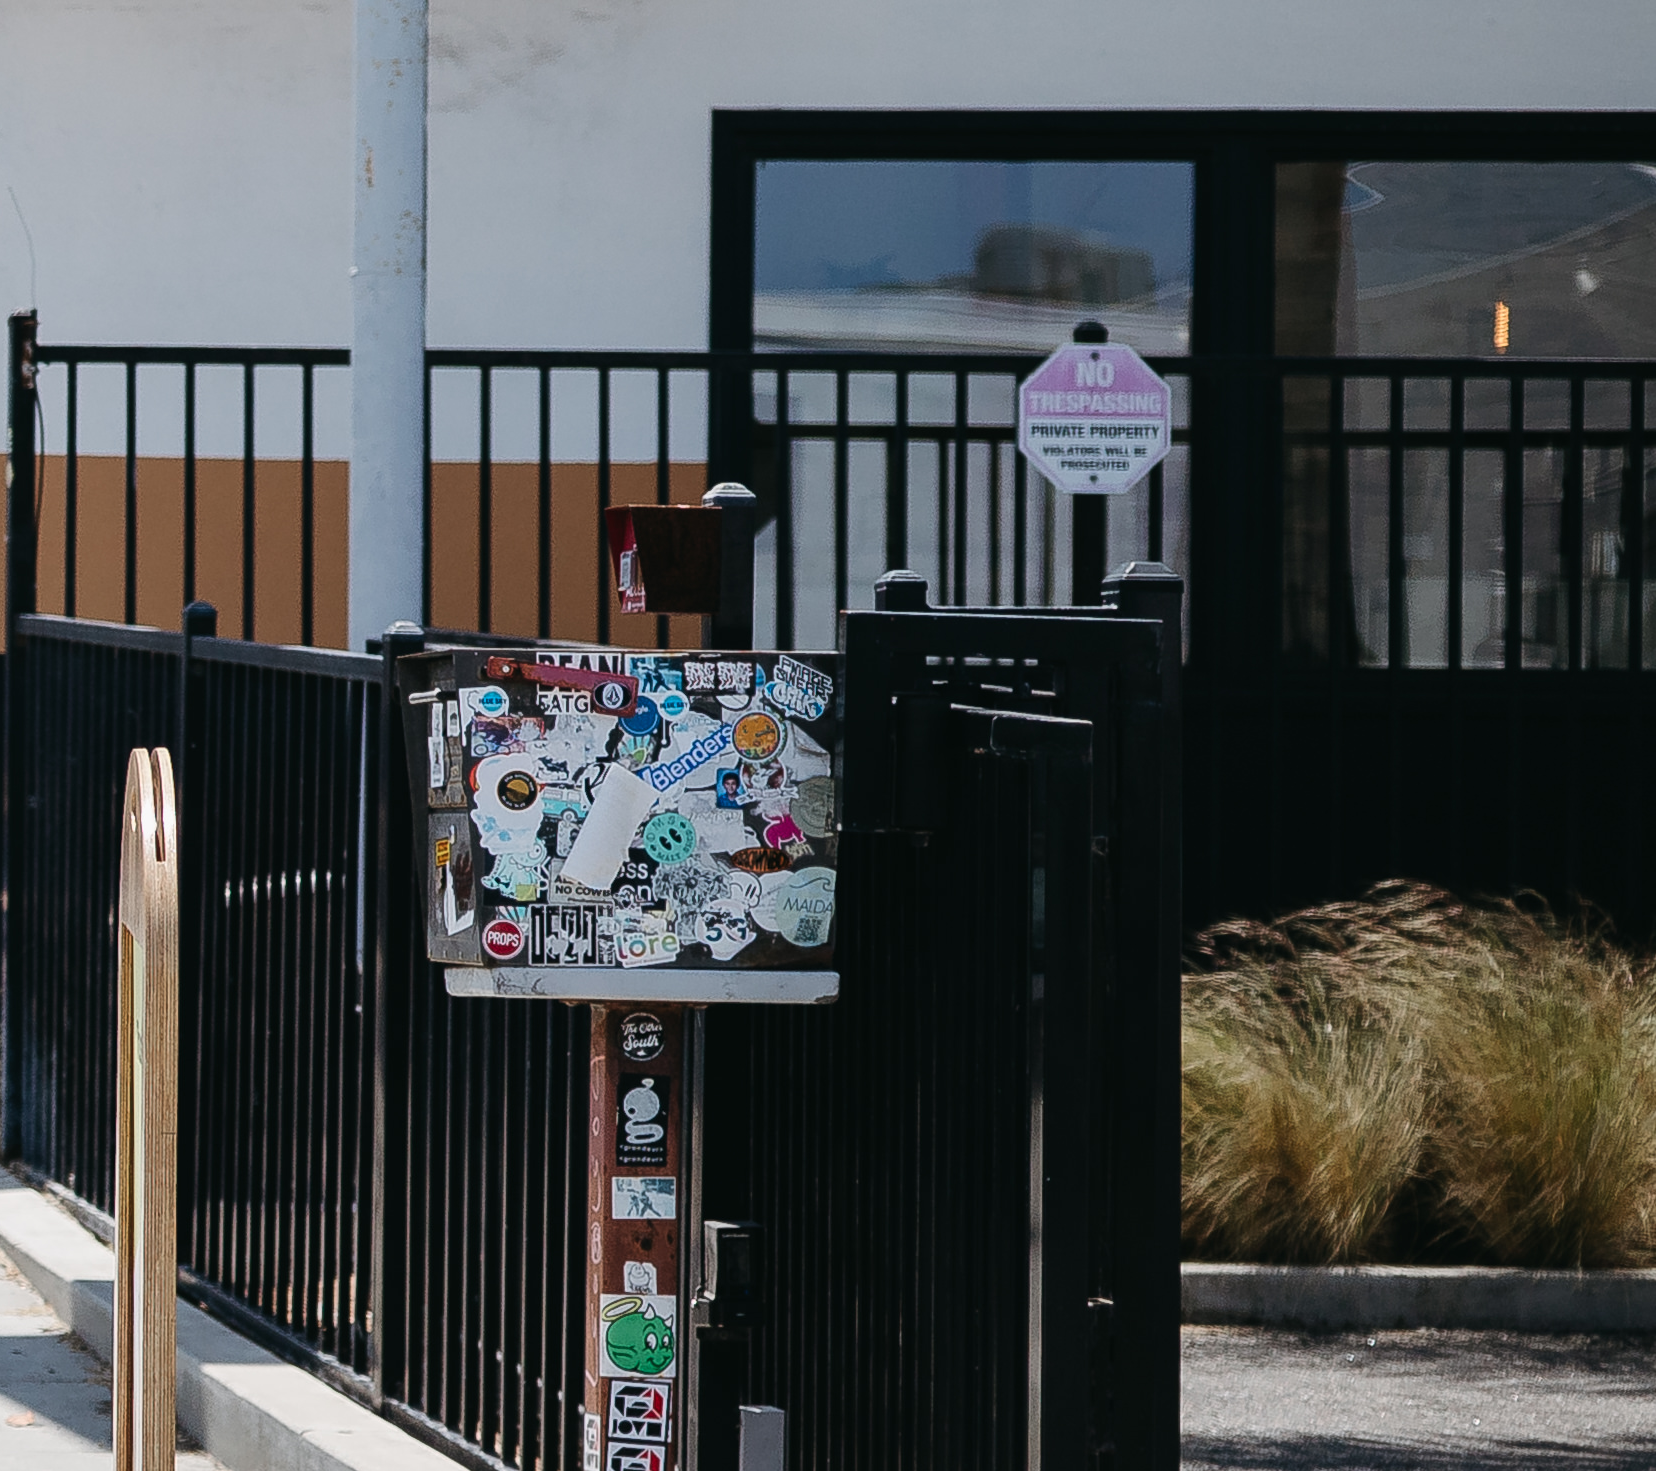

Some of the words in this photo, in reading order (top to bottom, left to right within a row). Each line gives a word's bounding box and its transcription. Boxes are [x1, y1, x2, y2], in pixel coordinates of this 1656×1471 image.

[1076, 362, 1115, 388] NO
[1030, 391, 1162, 414] TRESPASSING
[1031, 424, 1085, 439] PRIVATE
[1090, 425, 1160, 440] PROPERTY
[1043, 445, 1101, 457] VIOLATORS
[1105, 446, 1129, 457] WILL
[1060, 460, 1130, 471] PROSECUTED
[653, 726, 732, 791] Blenders
[555, 885, 572, 895] NO
[487, 931, 520, 947] PROPS
[621, 1023, 638, 1036] The
[622, 1034, 660, 1051] South
